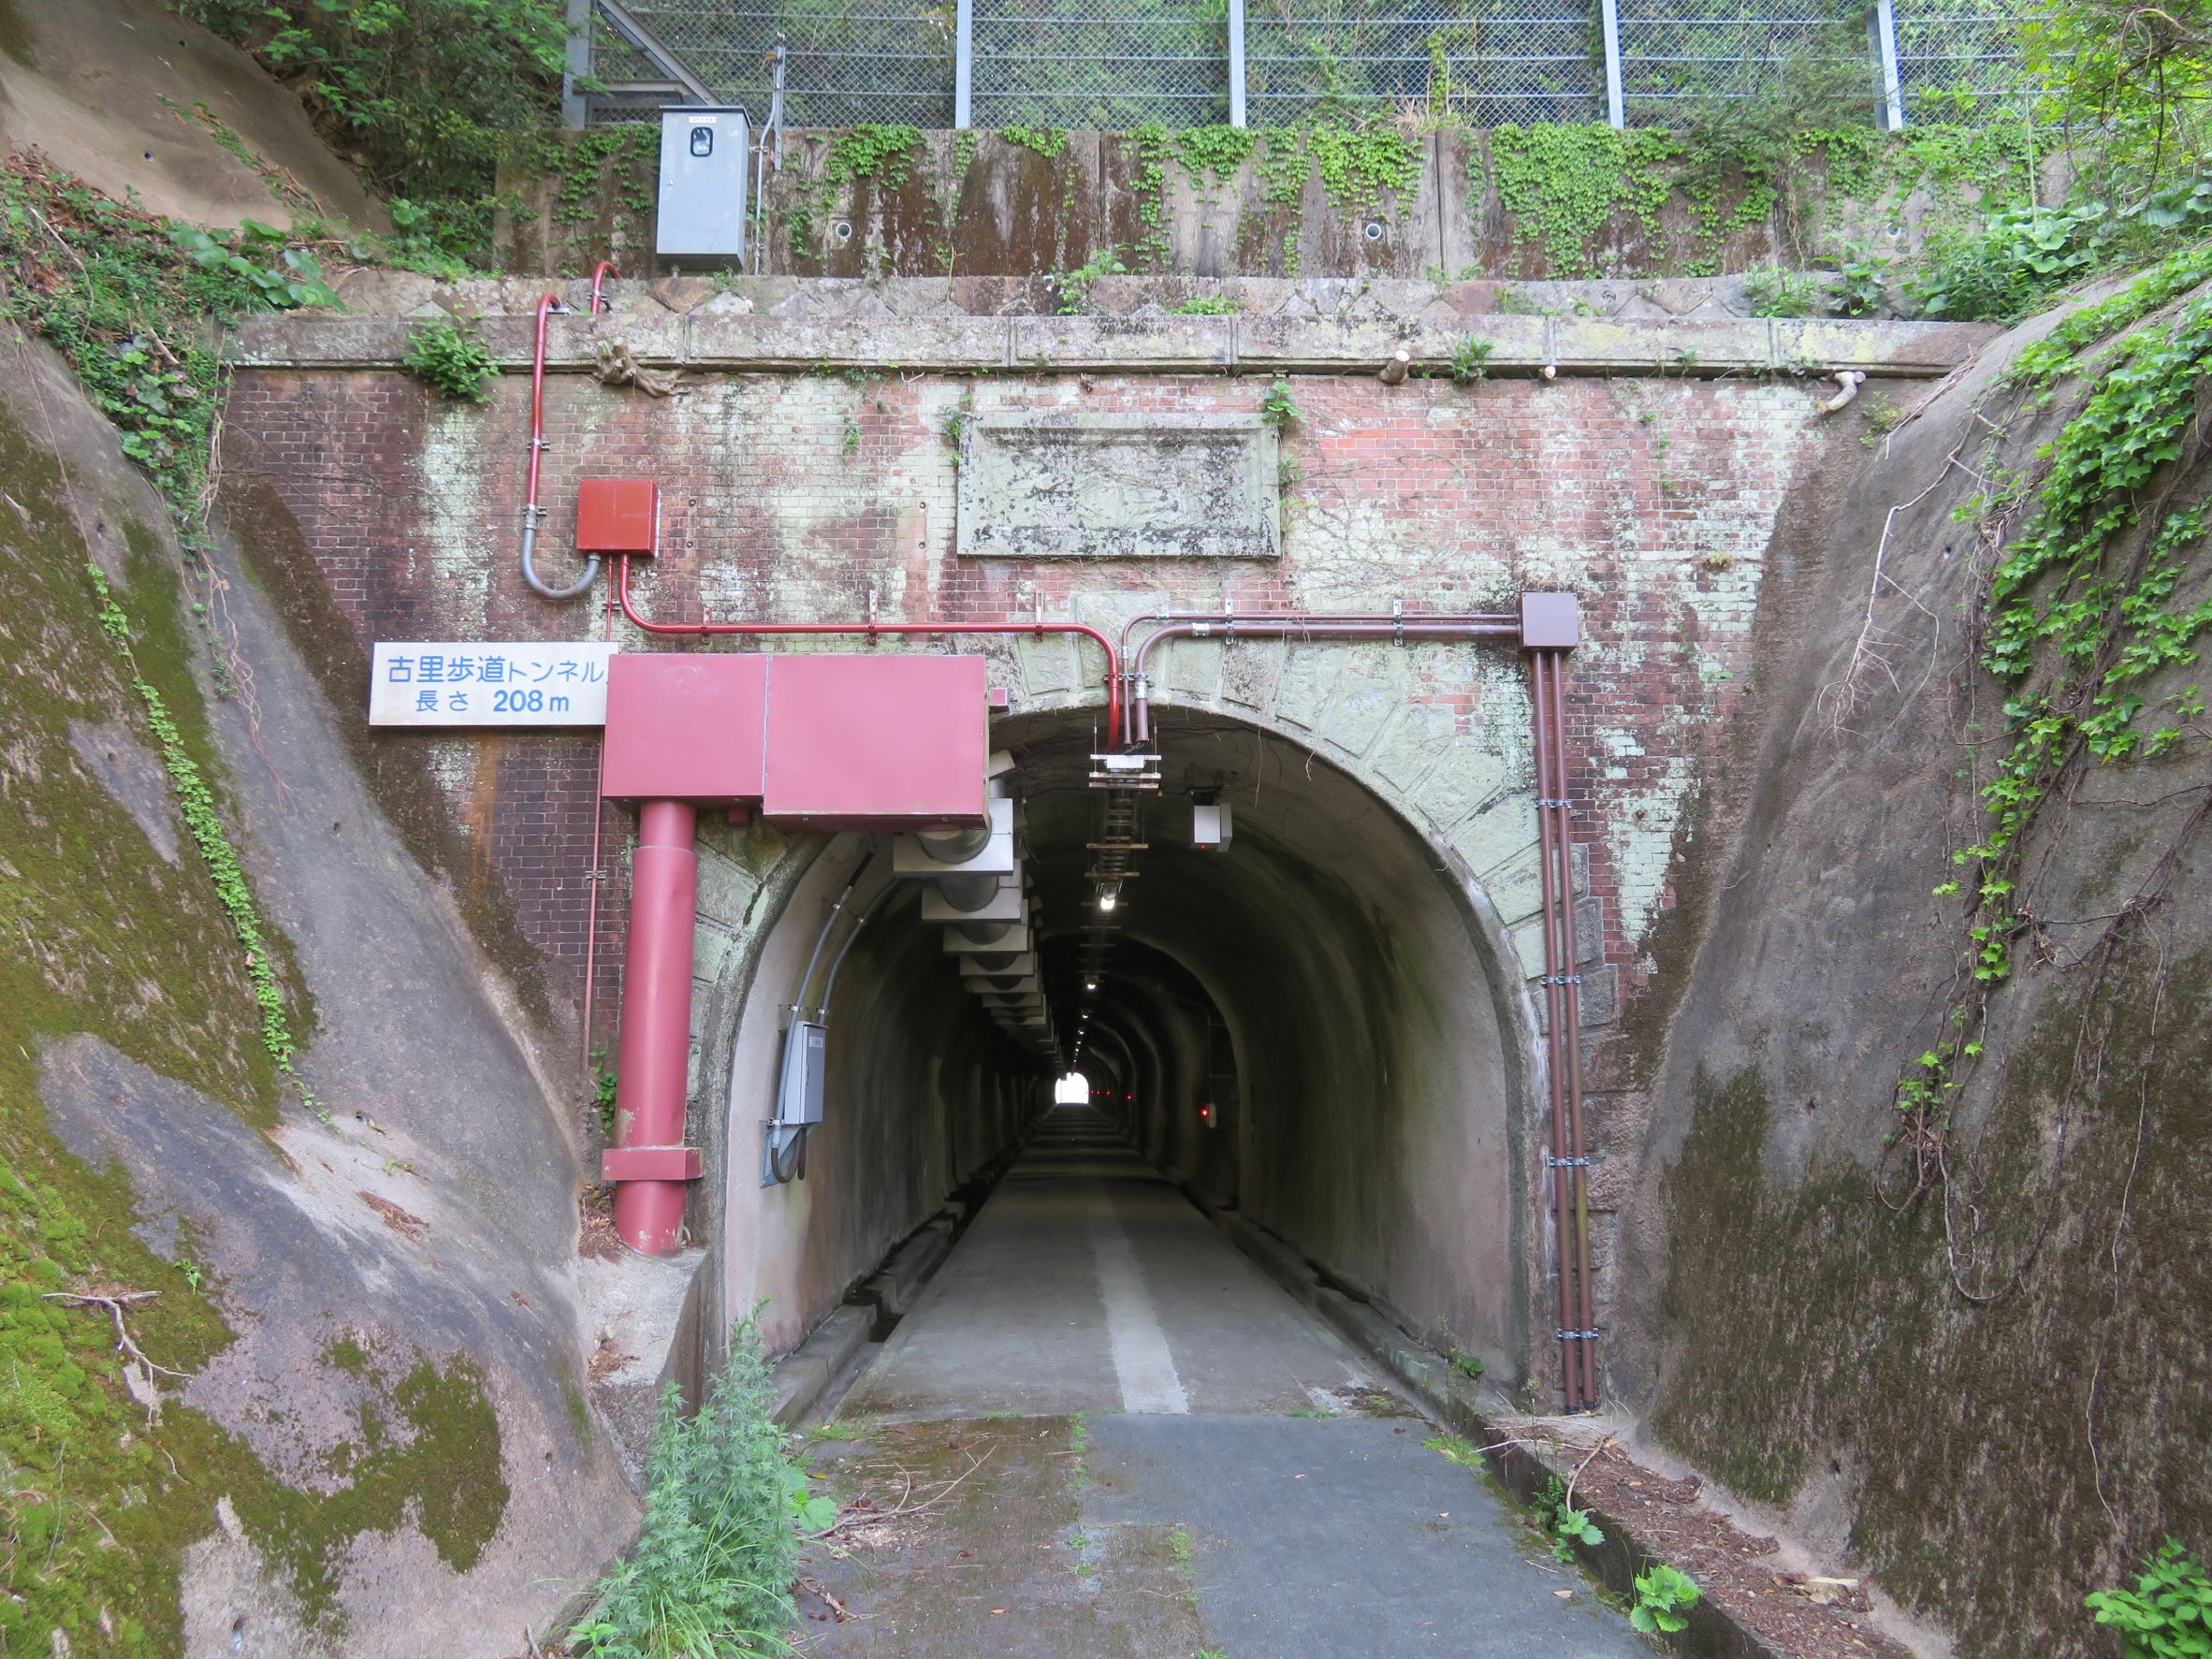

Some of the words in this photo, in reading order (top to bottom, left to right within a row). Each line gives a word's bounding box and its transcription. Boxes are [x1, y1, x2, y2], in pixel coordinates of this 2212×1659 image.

[387, 655, 605, 684] 古里歩道トンネル
[415, 690, 470, 713] 長さ
